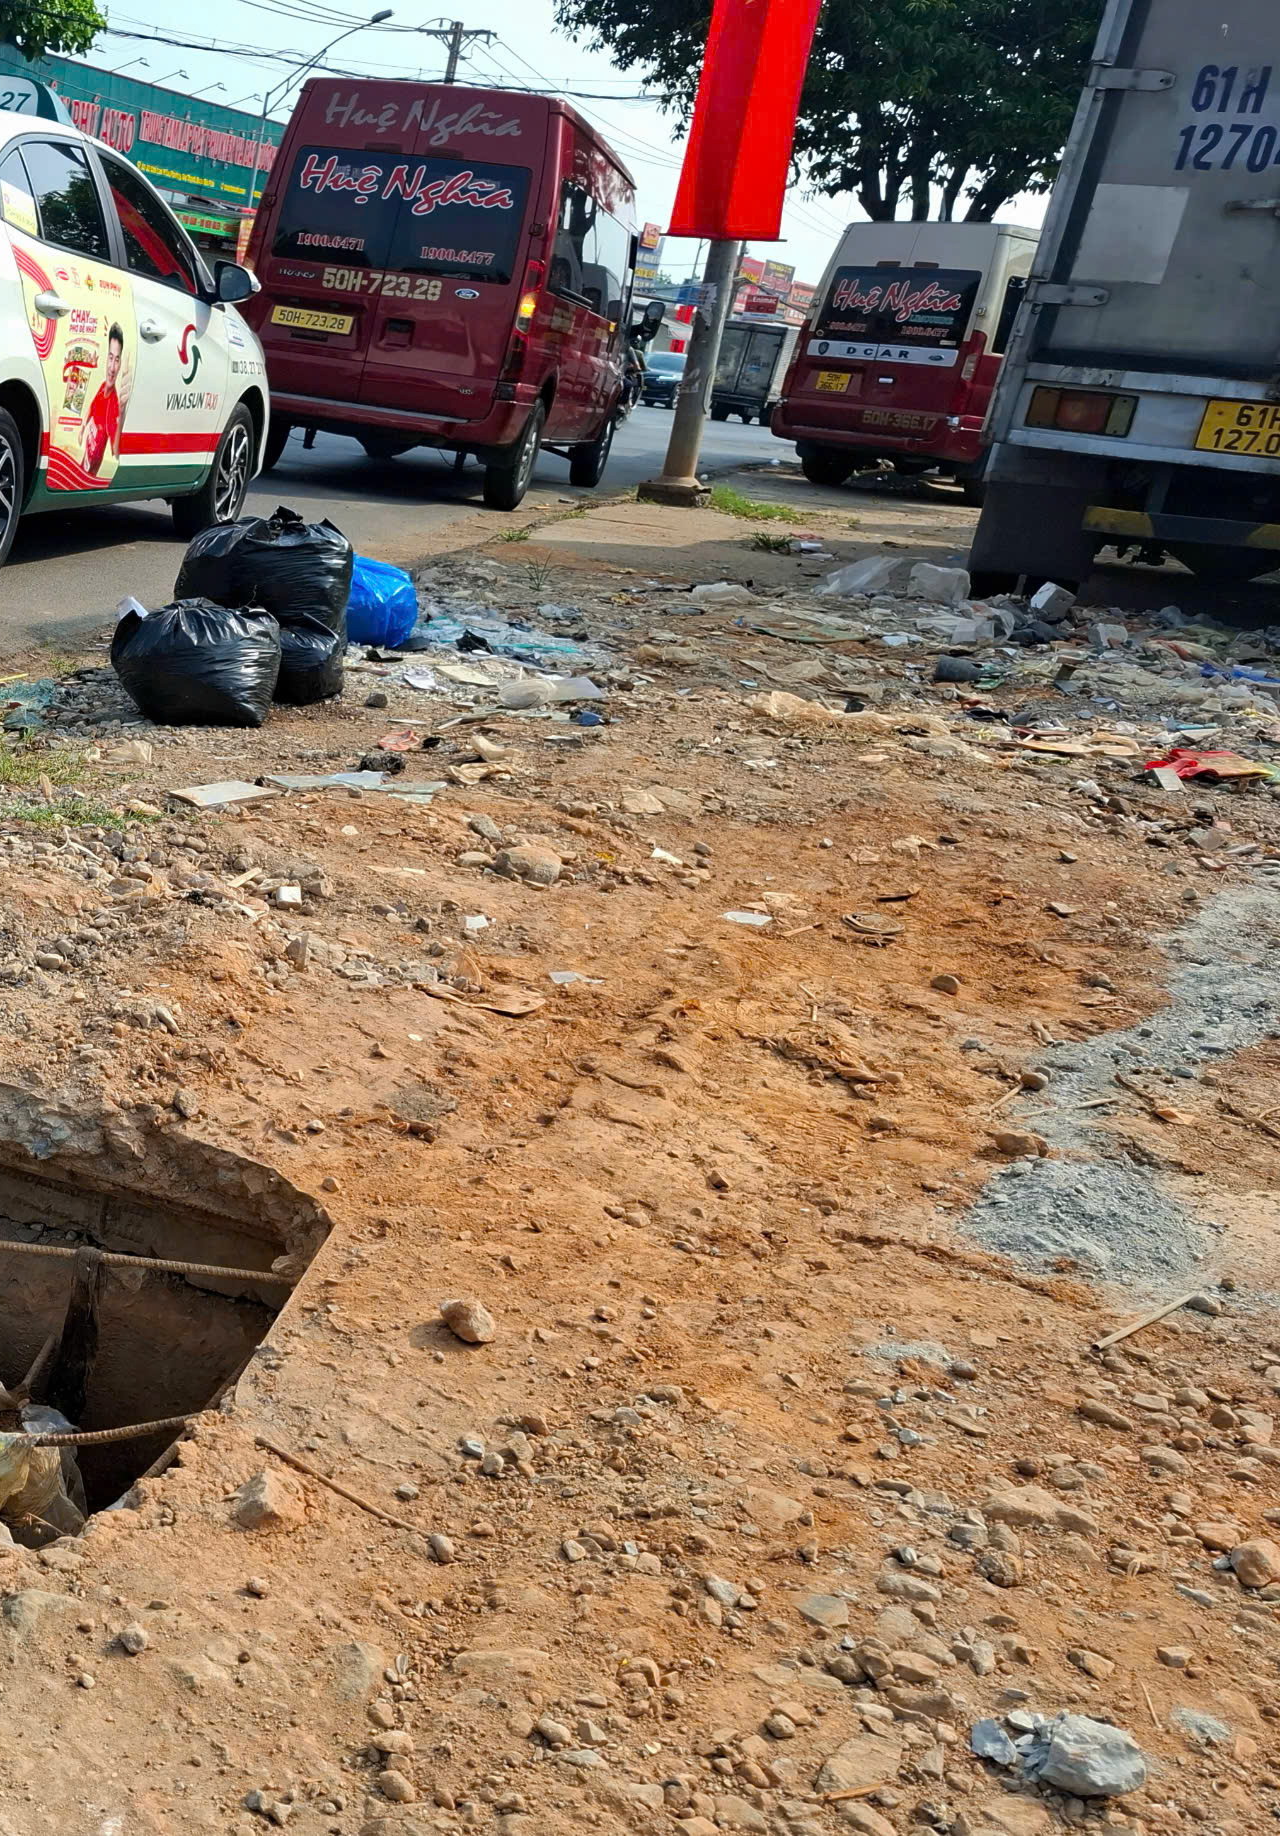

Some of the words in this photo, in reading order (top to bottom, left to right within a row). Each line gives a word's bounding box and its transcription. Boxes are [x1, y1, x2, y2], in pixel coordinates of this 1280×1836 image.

[1192, 64, 1272, 114] 61H
[325, 92, 399, 133] Huệ
[401, 99, 522, 146] Nghĩa
[301, 154, 383, 204] Huệ
[381, 164, 514, 215] Nghĩa
[420, 246, 496, 266] 1900.6477
[322, 267, 442, 301] 50H-723.28
[833, 278, 883, 314] Huệ
[879, 280, 961, 322] Nghĩa
[277, 309, 346, 330] 50H-723.28
[166, 392, 205, 411] VINASUN
[204, 392, 219, 411] TAXI
